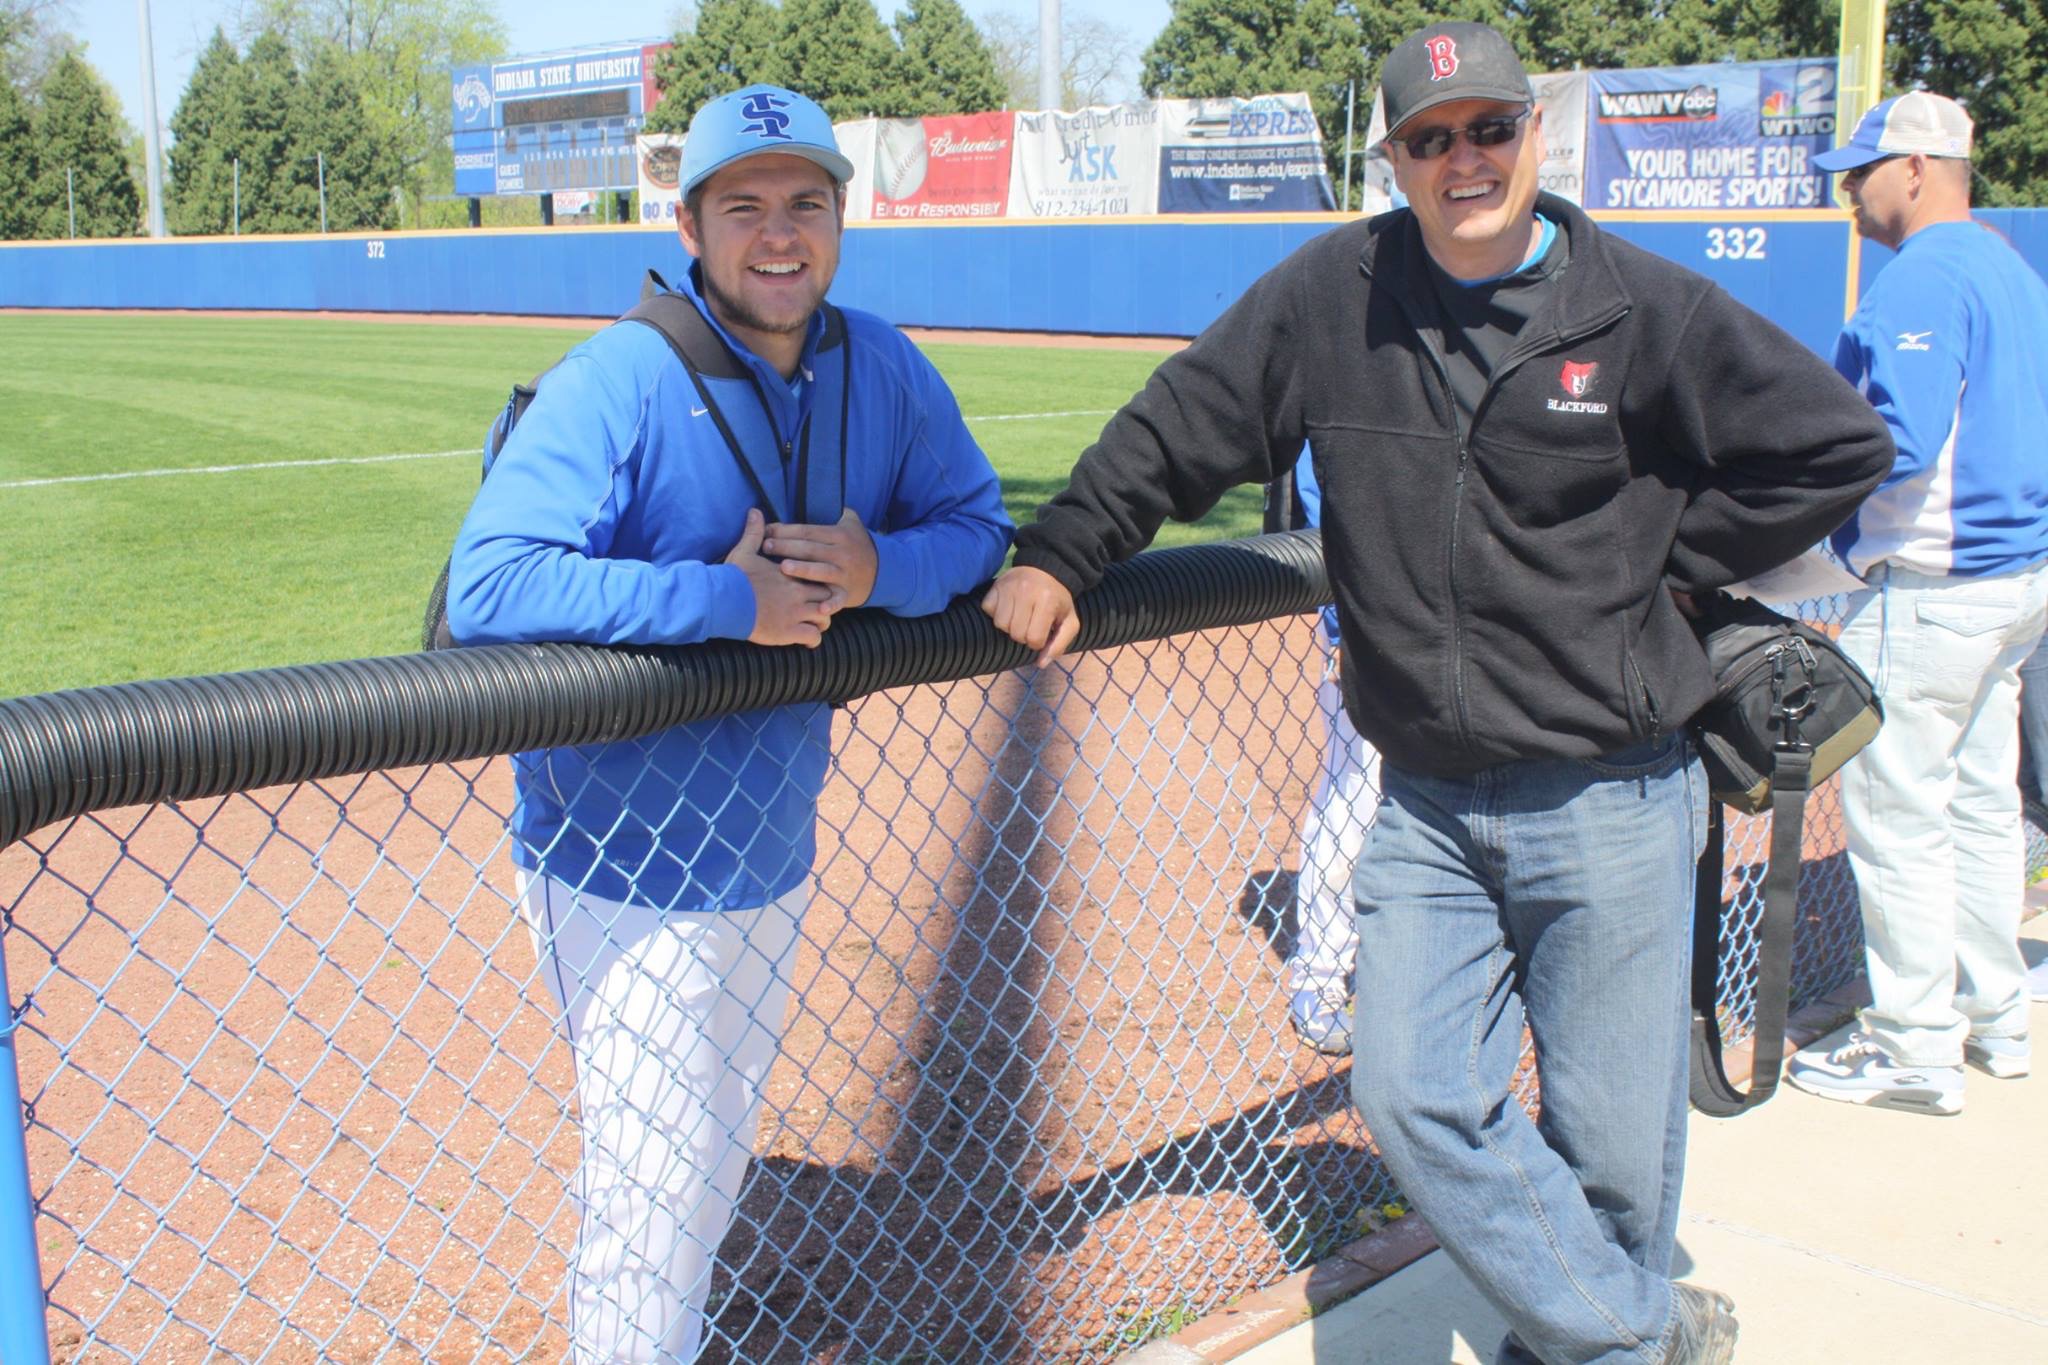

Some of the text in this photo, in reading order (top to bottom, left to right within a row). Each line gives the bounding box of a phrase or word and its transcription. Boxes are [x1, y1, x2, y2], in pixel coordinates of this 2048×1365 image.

[1425, 34, 1460, 81] B
[495, 69, 536, 92] INDIANA
[540, 64, 572, 87] STATE
[576, 56, 640, 82] UNIVERSITY
[1600, 92, 1717, 116] WAWV abc
[1796, 67, 1834, 116] 2
[1761, 117, 1835, 136] WTWO
[1068, 144, 1118, 182] ASK
[1626, 145, 1807, 178] YOUR HOME FOR
[1607, 176, 1823, 208] SYCAMORE SPORTS!
[876, 202, 918, 217] EJOY
[367, 240, 385, 258] 372
[1705, 227, 1767, 260] 332
[1547, 398, 1608, 414] BLACKFORD
